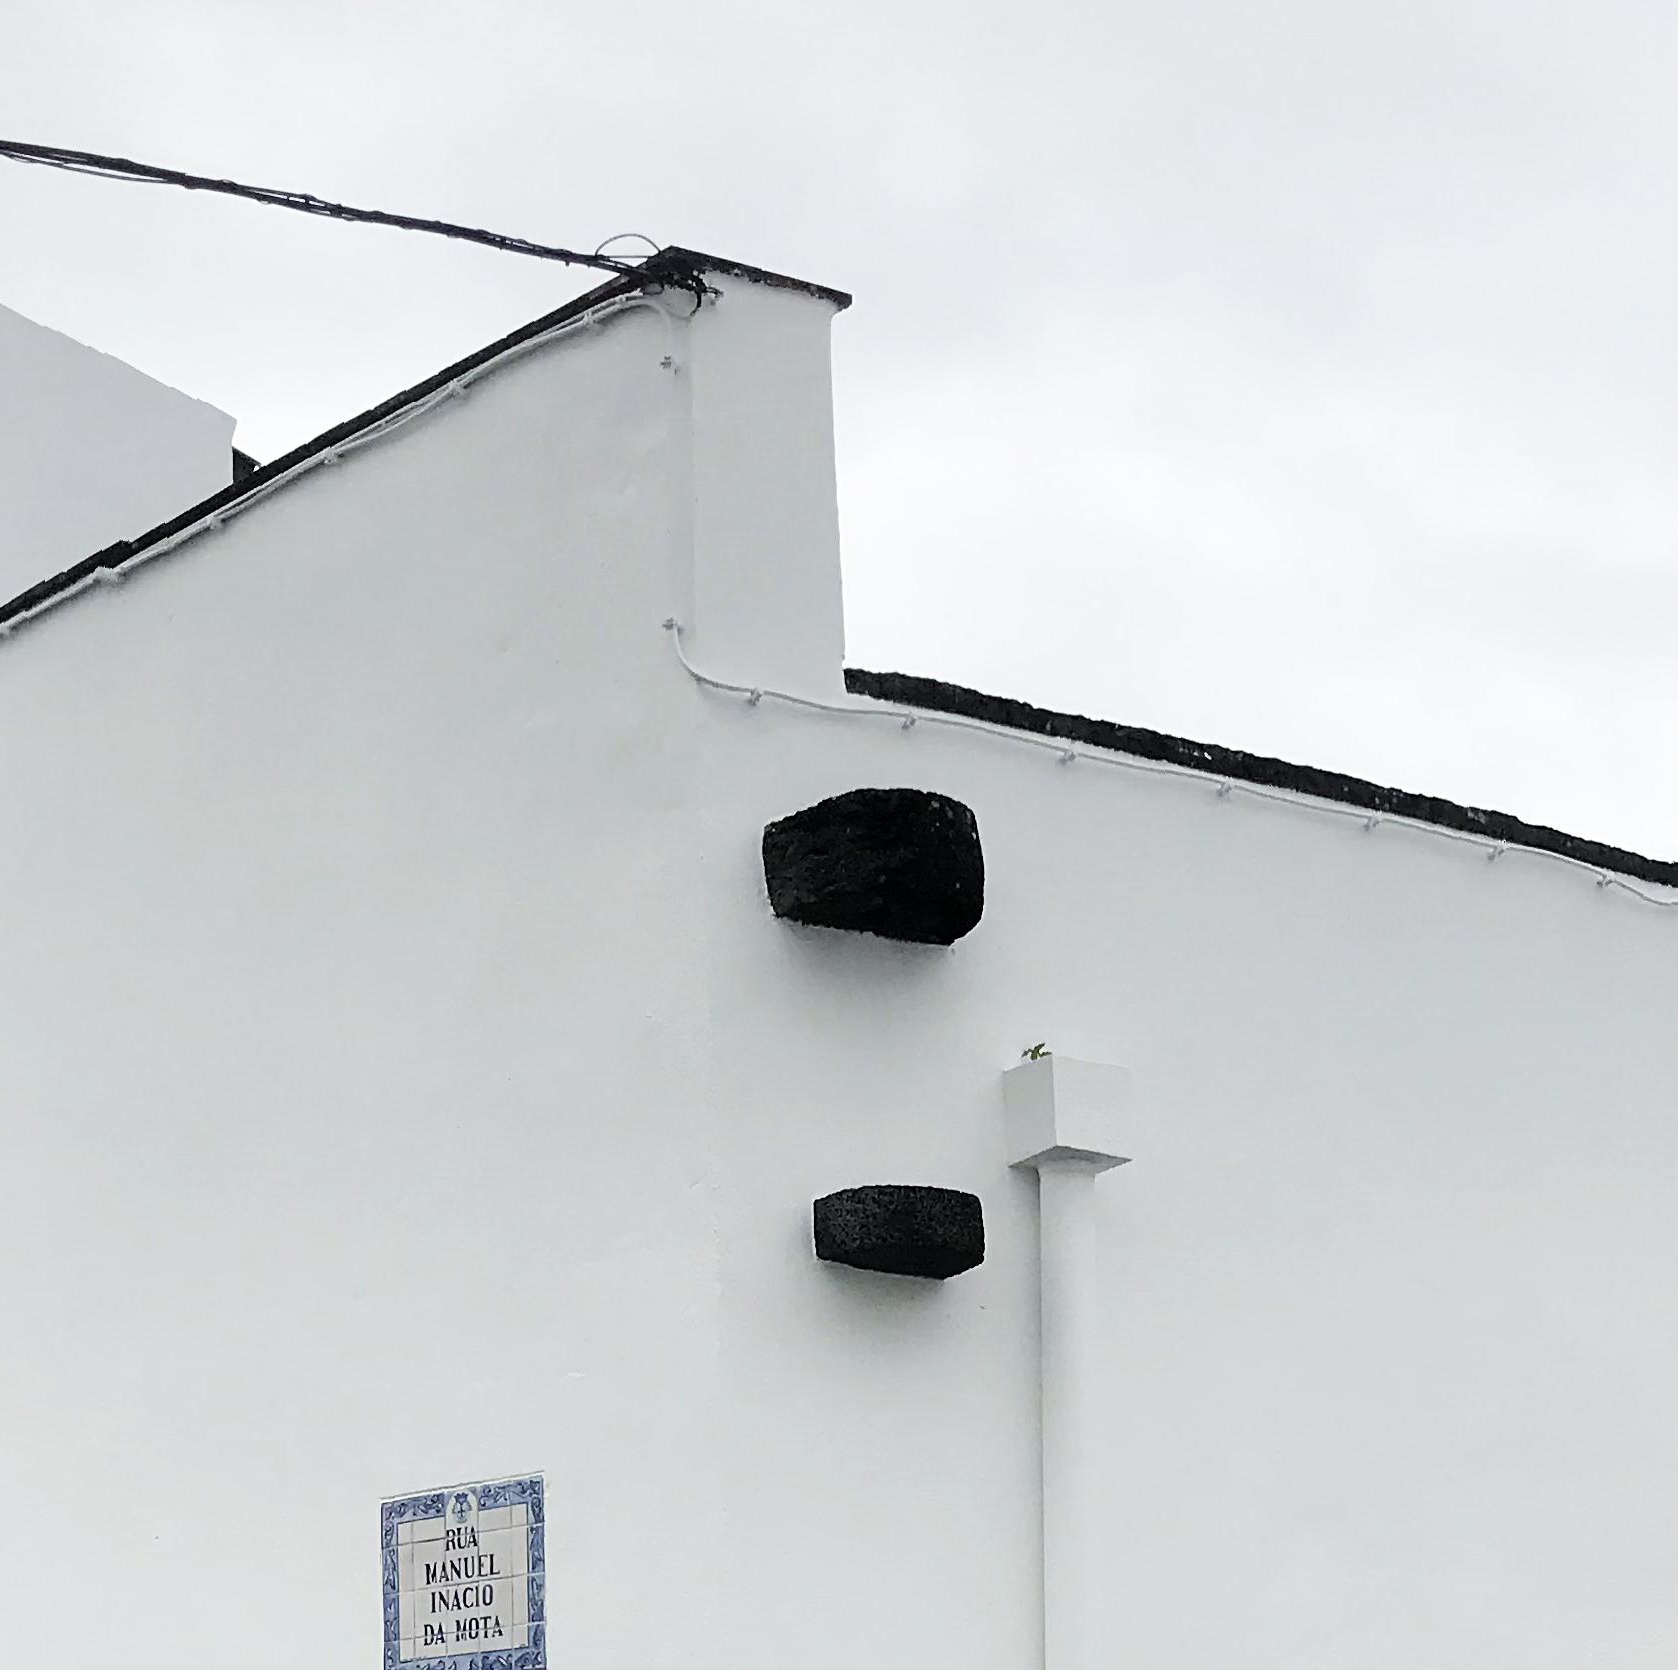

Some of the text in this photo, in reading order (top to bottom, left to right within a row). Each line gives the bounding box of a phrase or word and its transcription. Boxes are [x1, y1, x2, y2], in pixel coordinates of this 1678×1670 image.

[445, 1526, 478, 1551] RUA
[425, 1553, 500, 1585] MANUEL
[424, 1615, 503, 1646] DA MOTA
